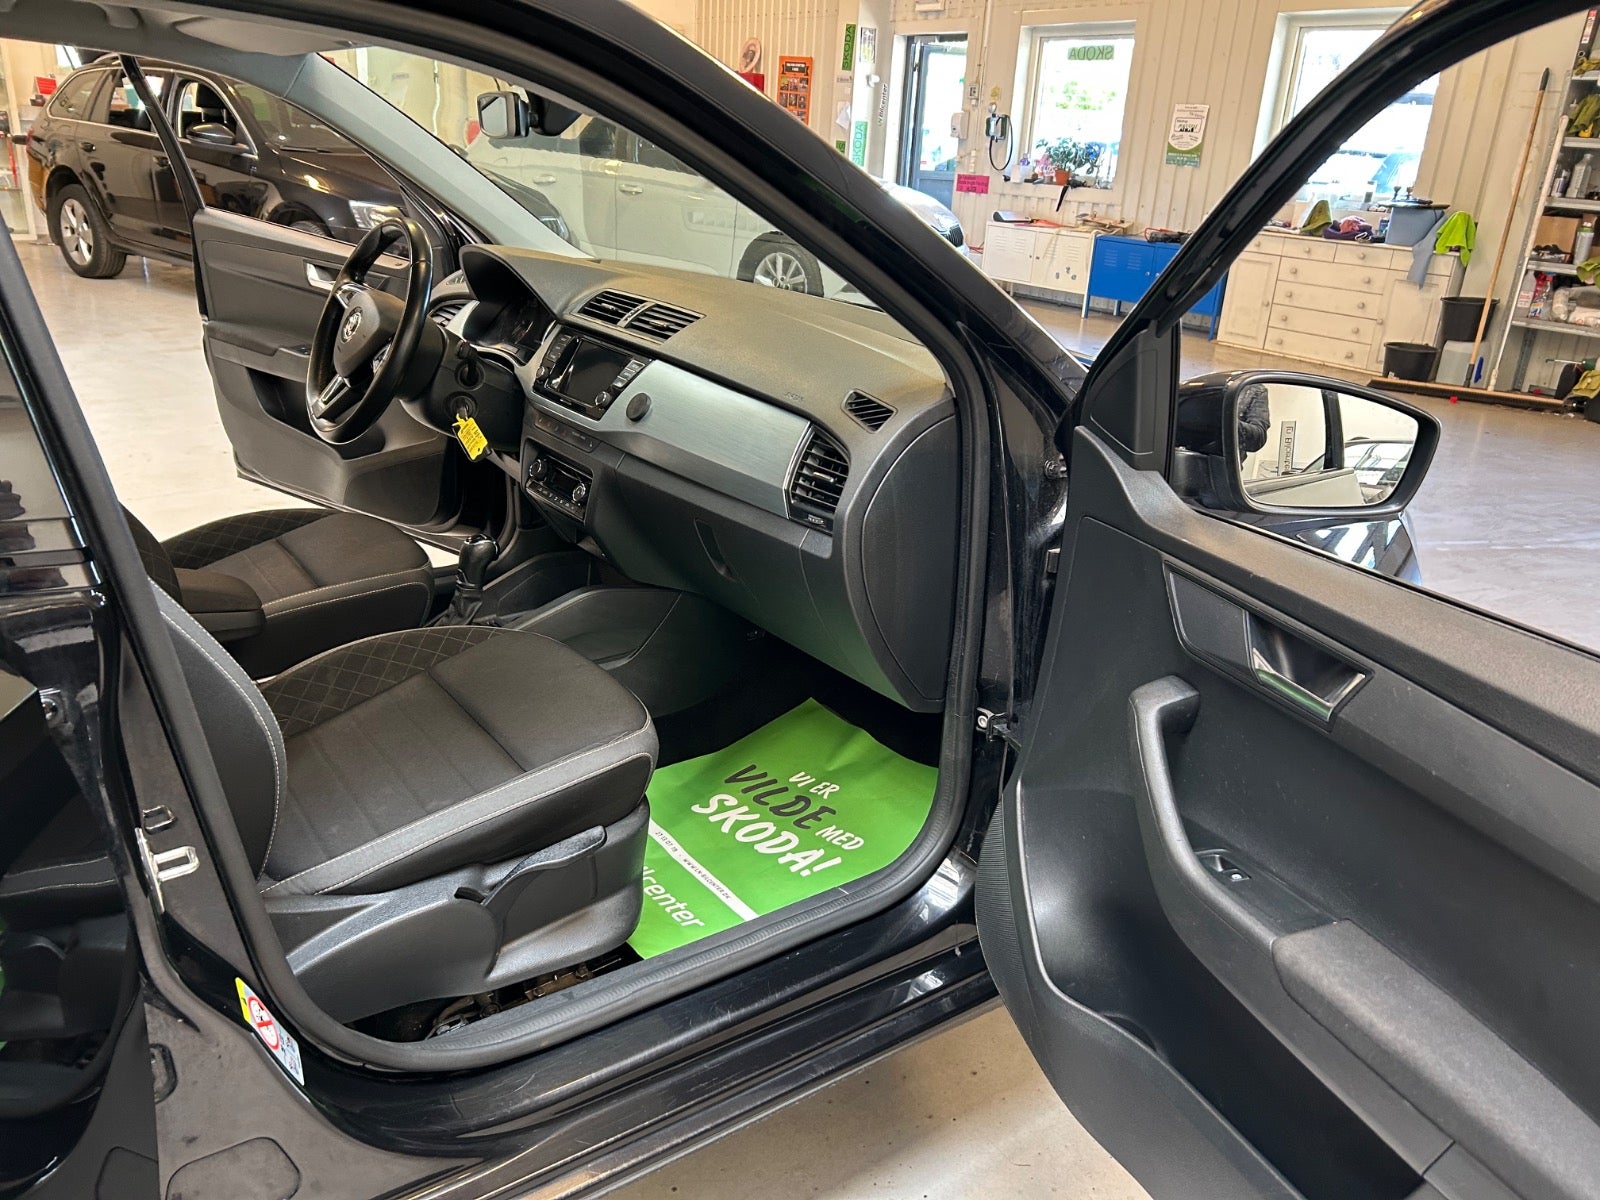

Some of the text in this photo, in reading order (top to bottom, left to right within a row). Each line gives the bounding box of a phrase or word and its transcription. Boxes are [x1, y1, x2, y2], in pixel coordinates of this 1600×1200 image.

[843, 25, 852, 69] SKODA
[853, 122, 864, 166] SKODA
[724, 764, 865, 850] VILDE MED
[788, 772, 840, 799] VI ER
[691, 794, 842, 877] SKODA!
